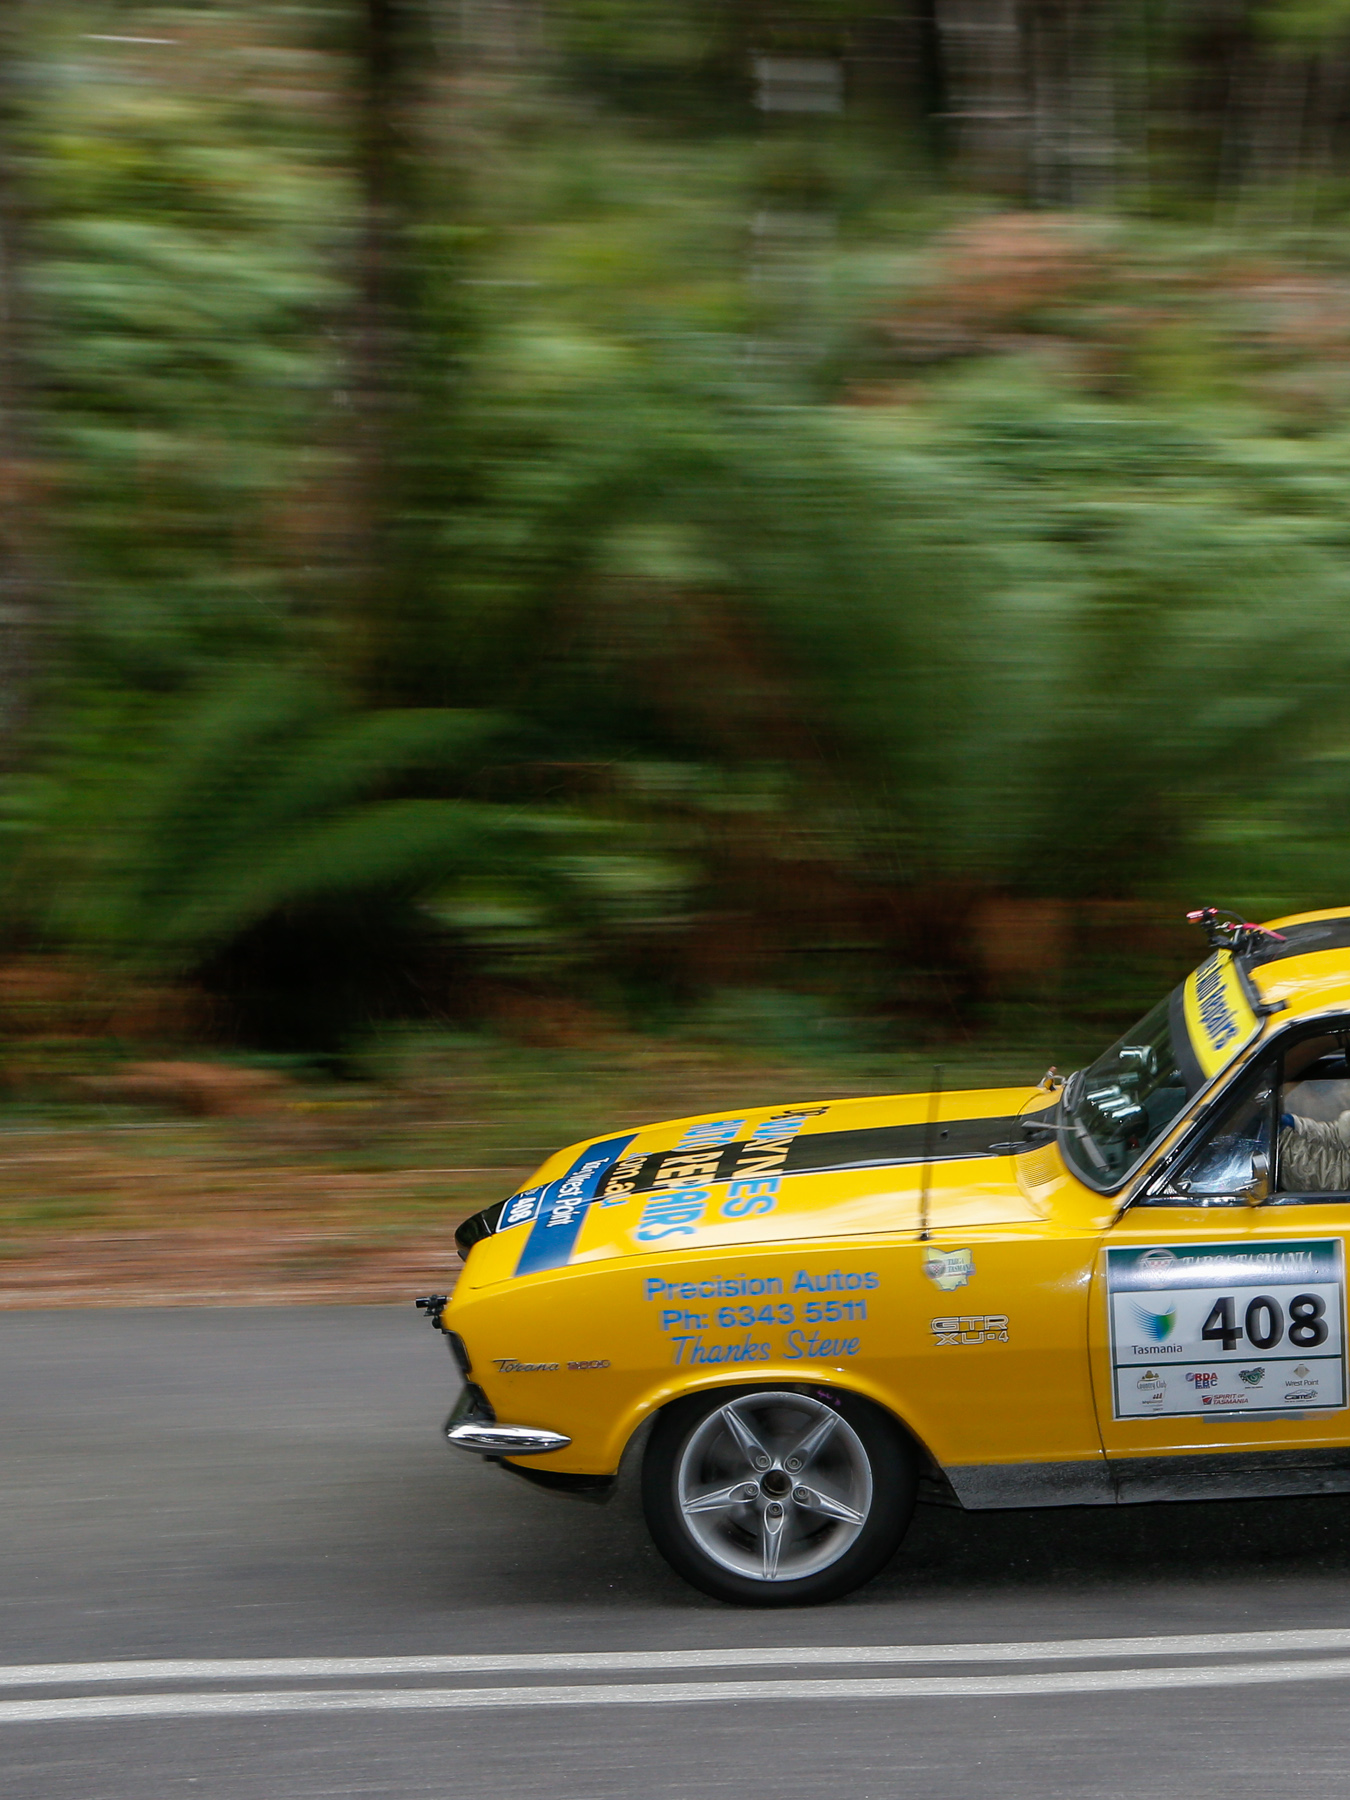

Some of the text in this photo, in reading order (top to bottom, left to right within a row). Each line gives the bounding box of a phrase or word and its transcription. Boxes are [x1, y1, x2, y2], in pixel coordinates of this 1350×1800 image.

[1199, 983, 1239, 1051] Repairs
[636, 1119, 748, 1241] AUTO REPAIRS
[720, 1116, 806, 1218] WAYNES
[508, 1197, 537, 1222] 408
[546, 1197, 582, 1227] Point
[643, 1269, 881, 1301] Precision Autos
[658, 1299, 868, 1331] Ph: 6343 5511
[931, 1314, 1010, 1332] GTR
[1202, 1293, 1329, 1351] 408
[668, 1329, 862, 1366] Thanks Steve
[1131, 1344, 1183, 1356] Tasmania
[491, 1358, 560, 1373] Torana
[1194, 1372, 1219, 1380] RDA
